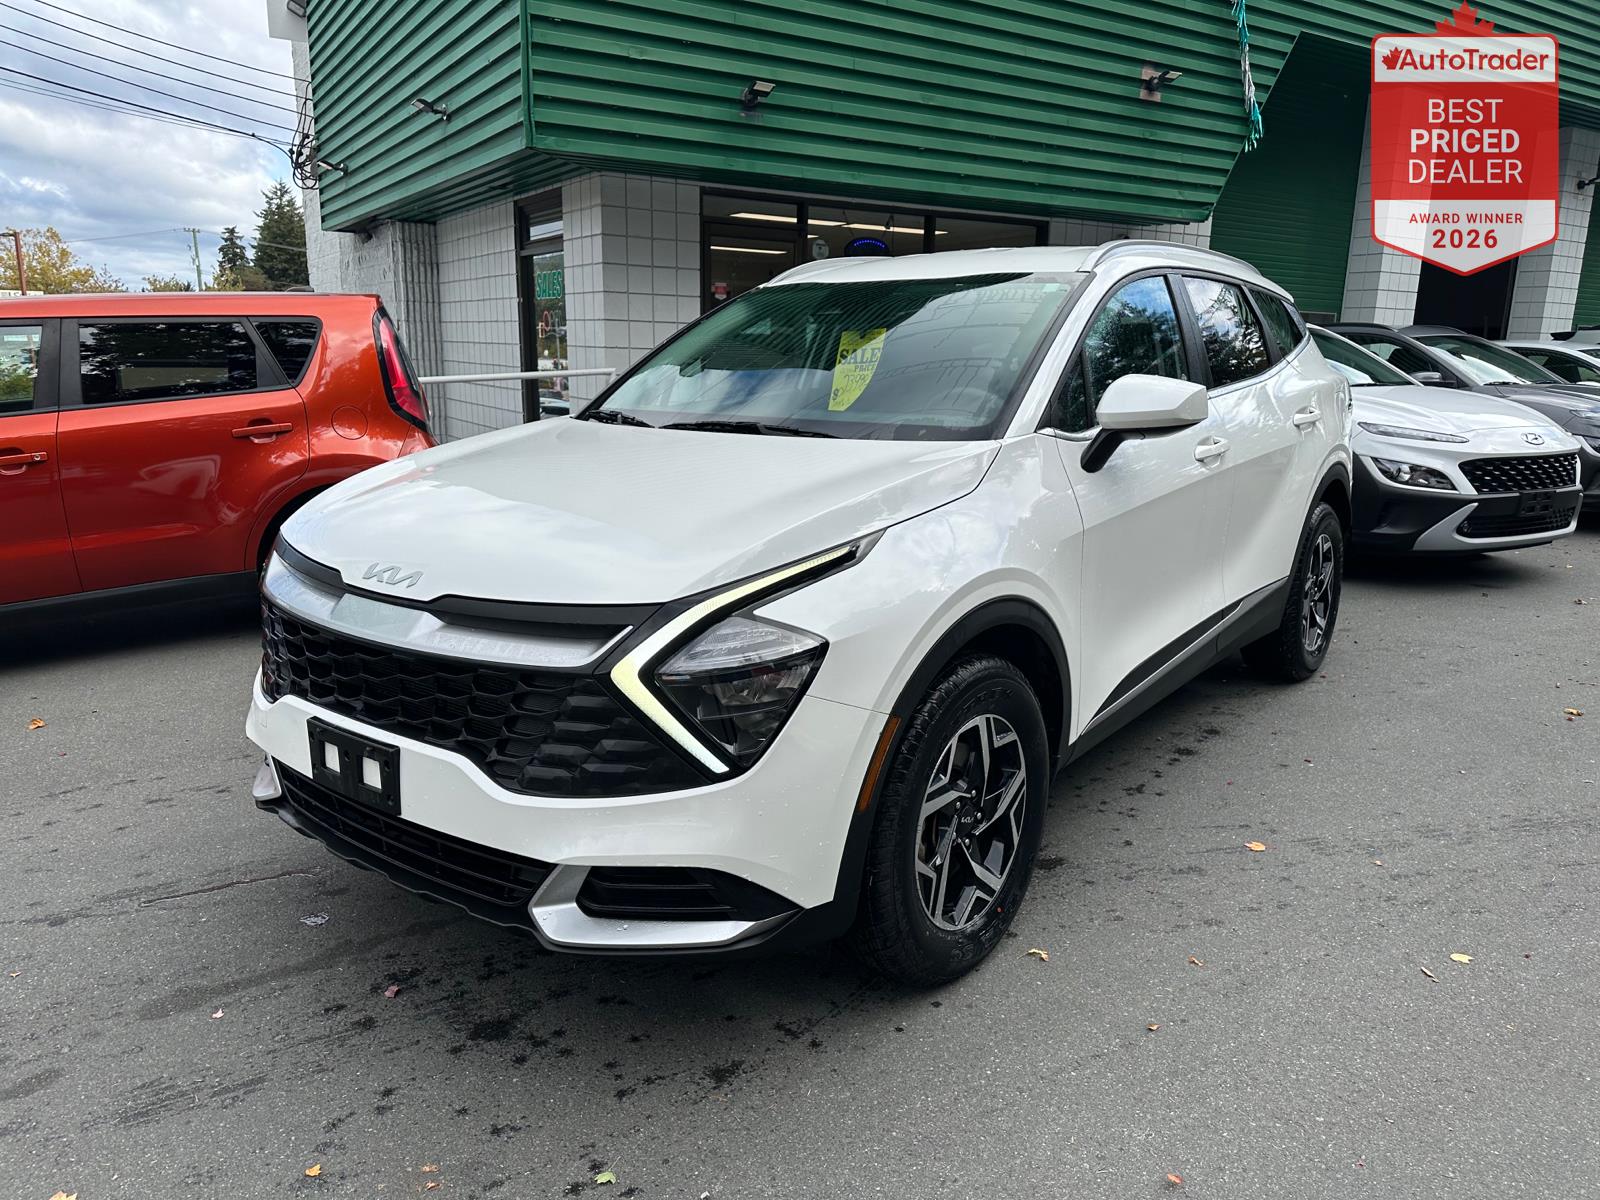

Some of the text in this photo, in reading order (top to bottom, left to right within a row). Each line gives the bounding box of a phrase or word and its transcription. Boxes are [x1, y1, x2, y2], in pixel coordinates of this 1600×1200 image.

[536, 270, 562, 300] SALES
[837, 347, 882, 365] SALE
[362, 562, 424, 589] KIA
